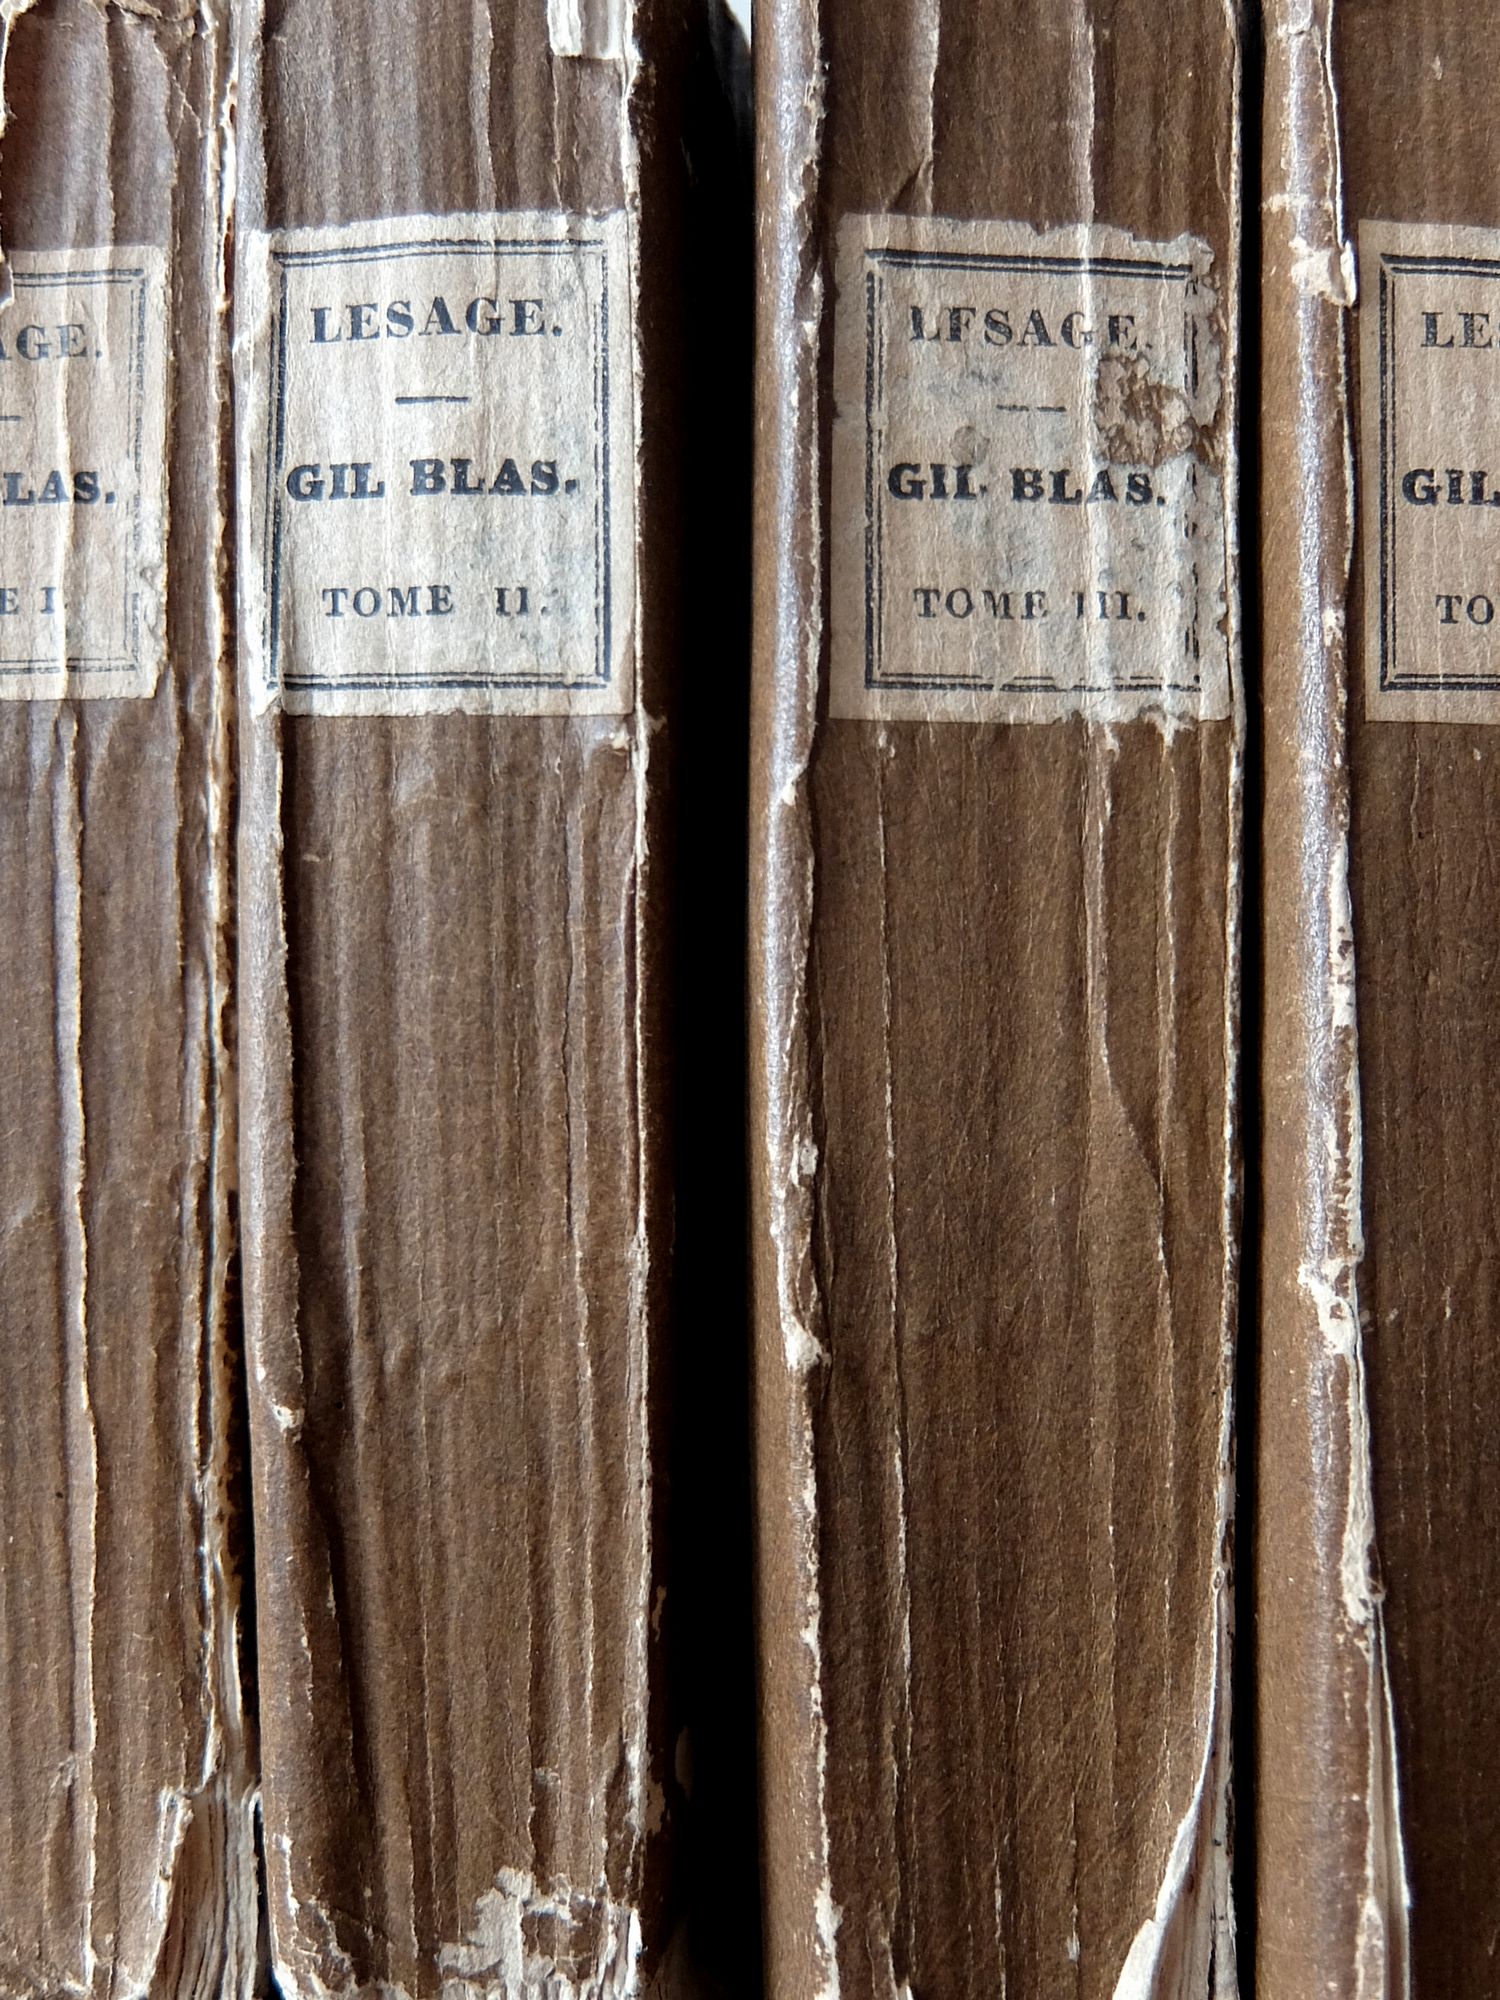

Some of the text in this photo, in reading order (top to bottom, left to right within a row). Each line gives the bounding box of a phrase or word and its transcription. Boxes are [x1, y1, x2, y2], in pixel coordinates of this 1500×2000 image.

[309, 295, 563, 344] LESAGE.
[1420, 310, 1500, 349] LE
[0, 323, 103, 361] GE.
[286, 457, 579, 502] GIL BLAS.
[1009, 468, 1167, 506] BLAS.
[1401, 468, 1500, 507] GIL
[321, 584, 550, 618] TOME II.
[913, 587, 1147, 622] TOME III.
